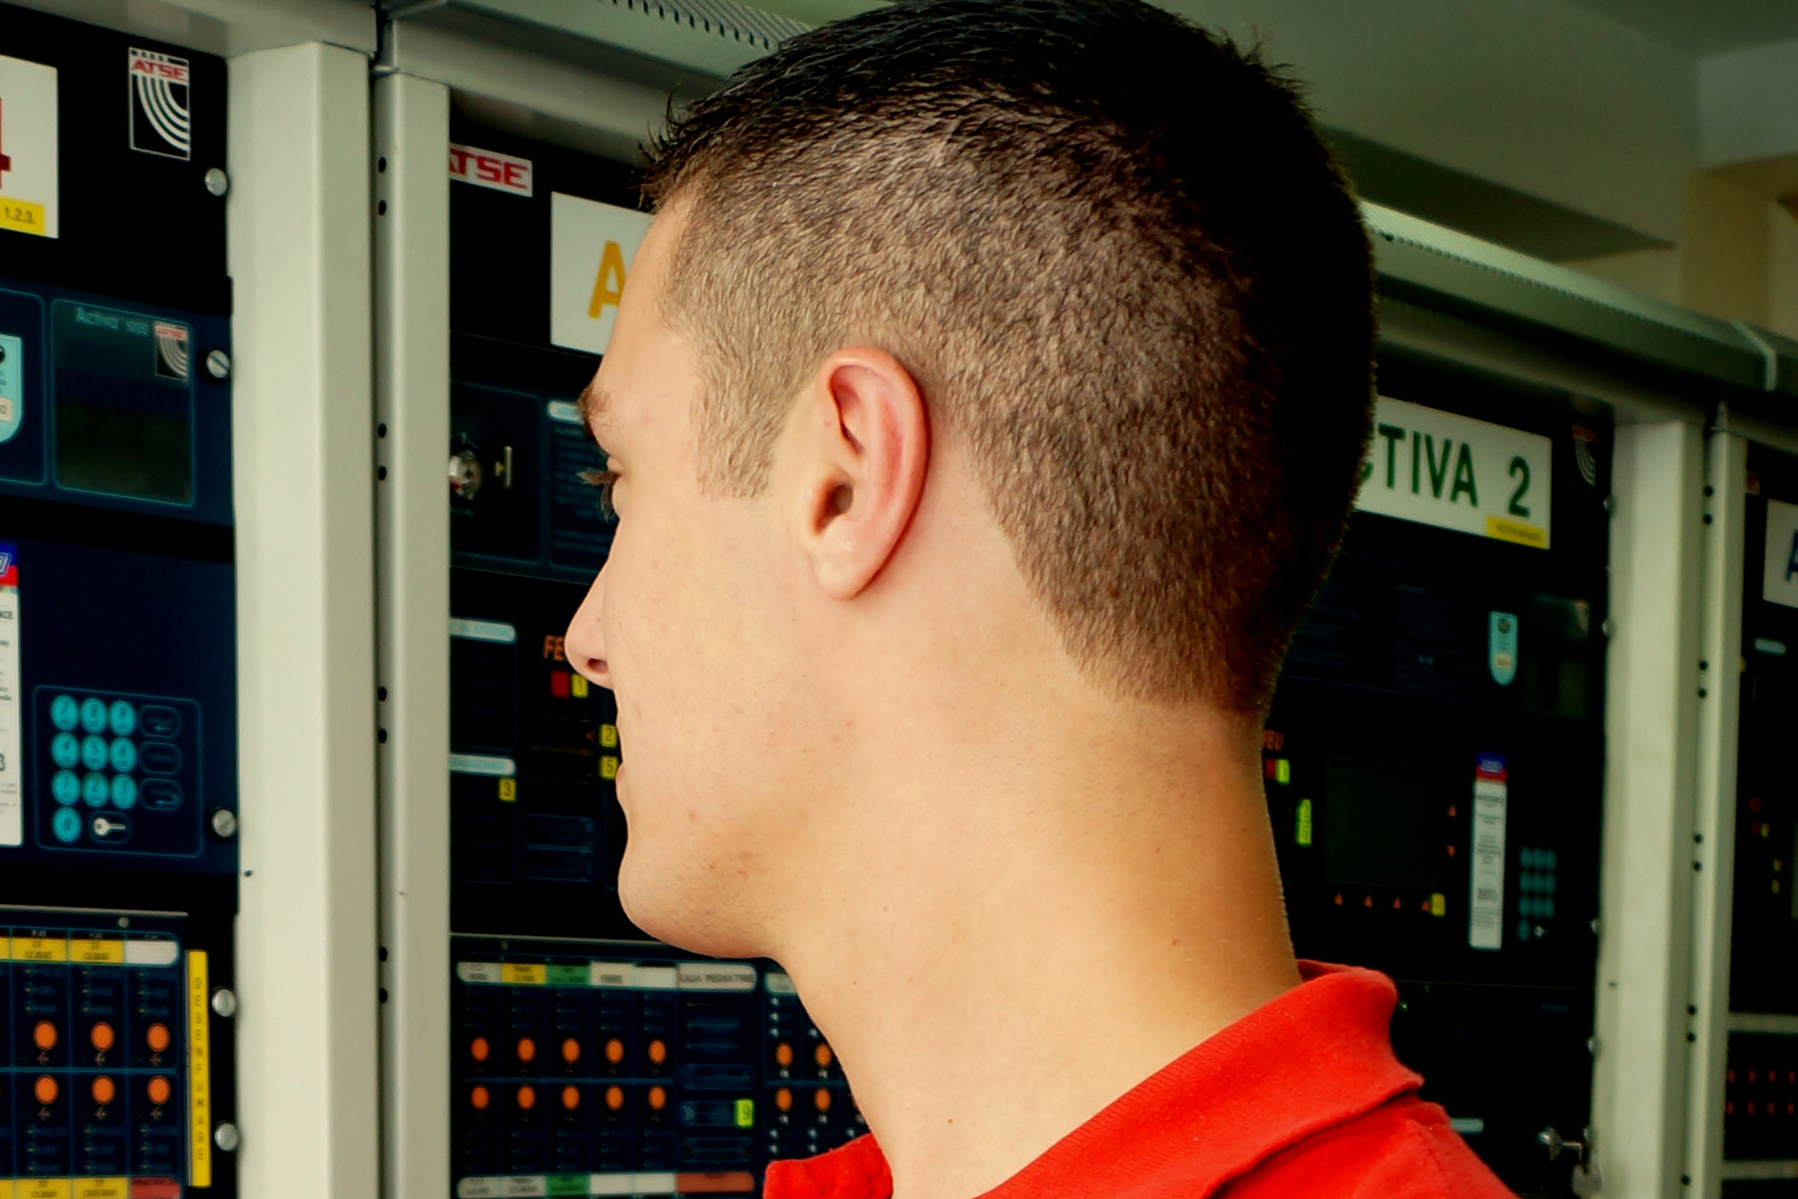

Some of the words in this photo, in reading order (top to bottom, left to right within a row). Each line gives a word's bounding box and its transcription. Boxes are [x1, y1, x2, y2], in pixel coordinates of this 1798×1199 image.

[131, 58, 188, 82] ATSE
[1362, 422, 1479, 510] TIVA
[1508, 455, 1531, 519] 2
